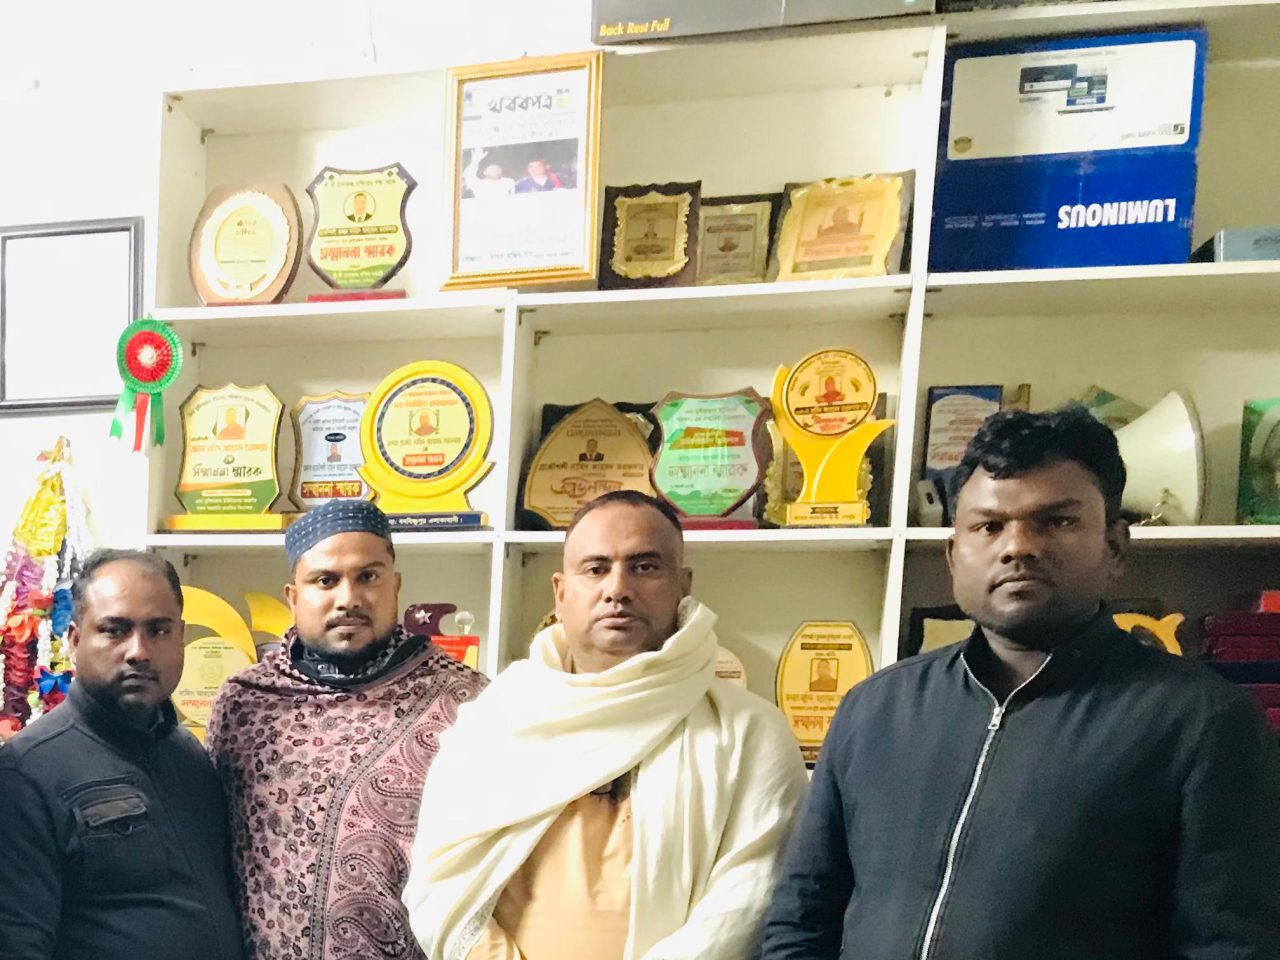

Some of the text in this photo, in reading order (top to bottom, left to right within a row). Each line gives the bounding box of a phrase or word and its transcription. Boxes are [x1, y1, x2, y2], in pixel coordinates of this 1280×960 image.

[600, 16, 671, 37] Back Rest Full
[1058, 197, 1177, 229] LUMINOUS
